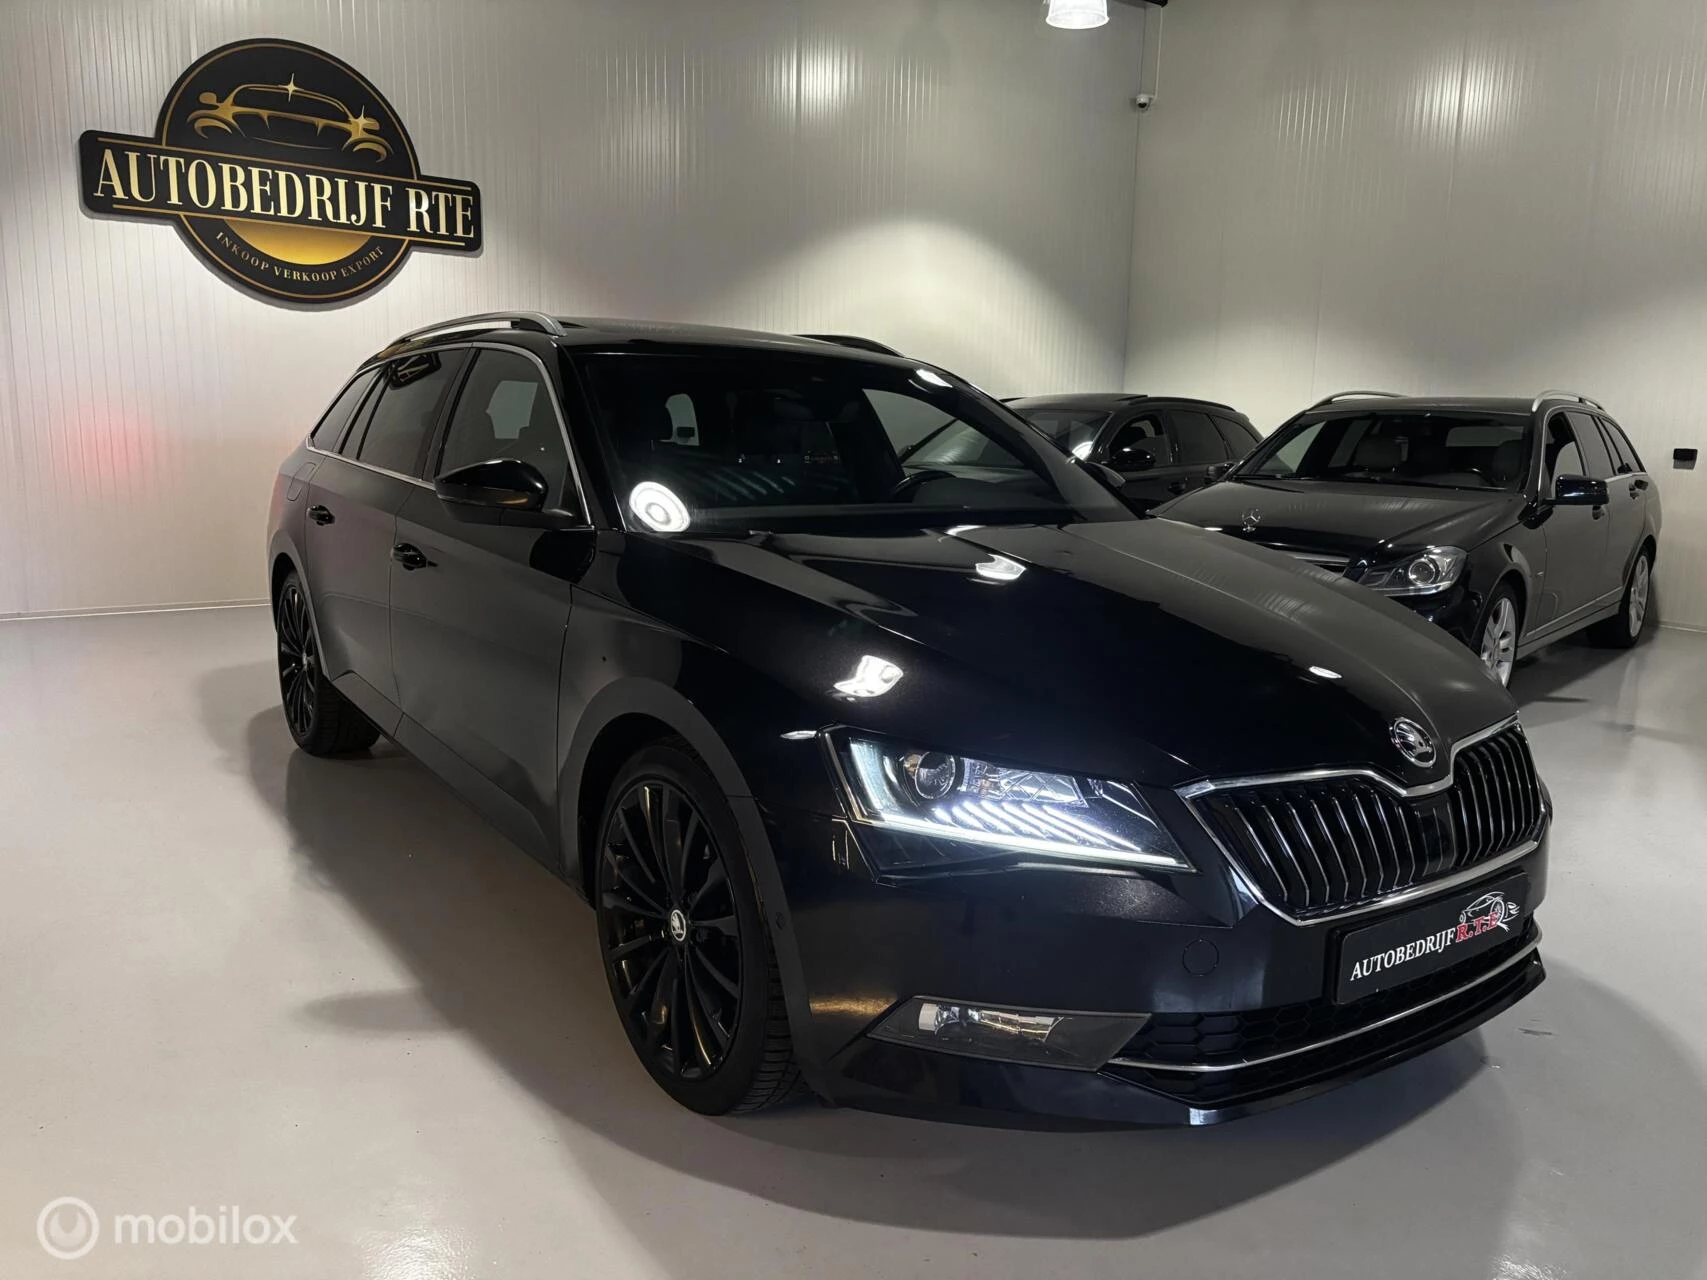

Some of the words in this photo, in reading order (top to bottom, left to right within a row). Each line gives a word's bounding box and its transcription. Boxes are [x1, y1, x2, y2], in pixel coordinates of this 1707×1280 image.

[93, 148, 393, 229] AUTOBEDRIJF
[404, 187, 475, 238] RTE
[215, 231, 270, 271] INKOOP
[273, 266, 338, 283] VERKOOP
[340, 245, 385, 279] EXPORT
[1350, 928, 1456, 981] AUTOBEDRIJF
